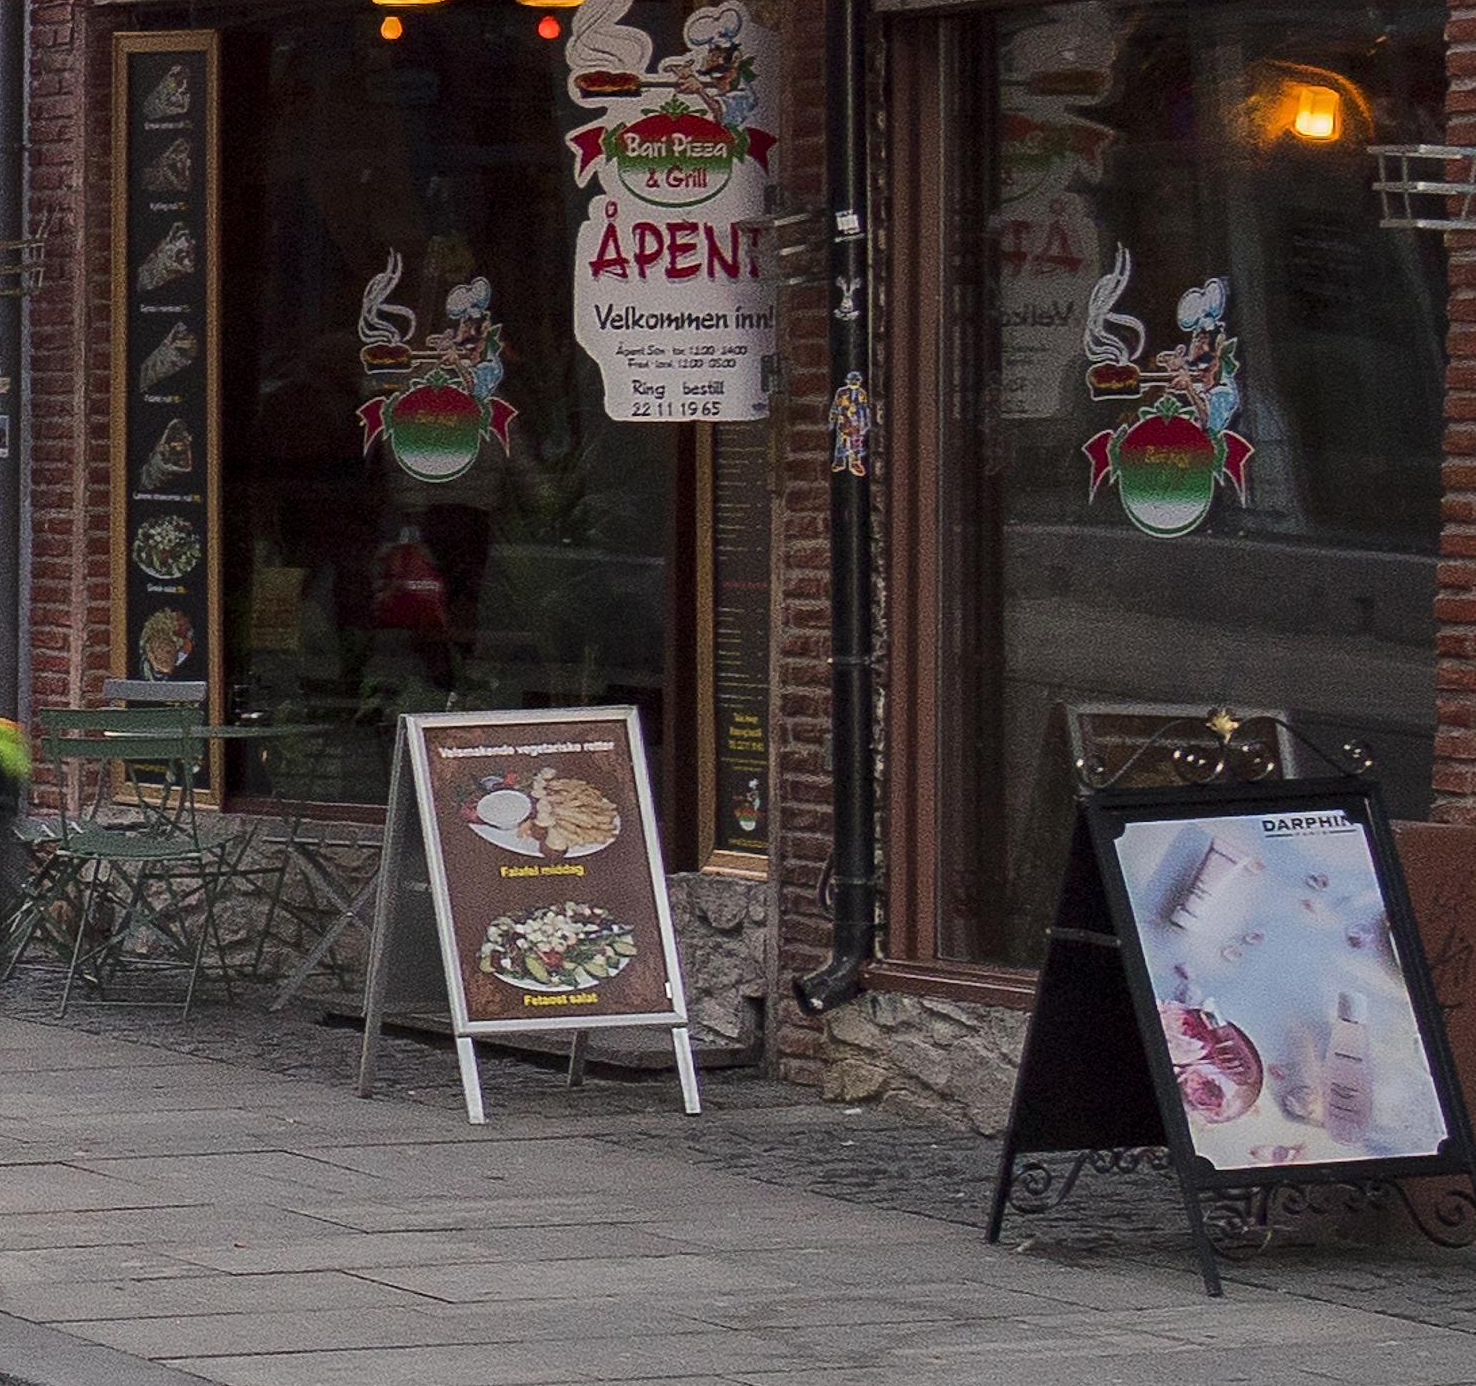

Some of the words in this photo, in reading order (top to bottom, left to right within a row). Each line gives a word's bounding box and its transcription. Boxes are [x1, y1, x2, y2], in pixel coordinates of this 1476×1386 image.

[624, 132, 668, 159] Bari
[672, 131, 728, 159] Pizza
[645, 168, 660, 189] &
[665, 165, 709, 189] Grill
[594, 303, 729, 331] Velkommen
[631, 379, 666, 399] Ring
[682, 380, 726, 395] bestill
